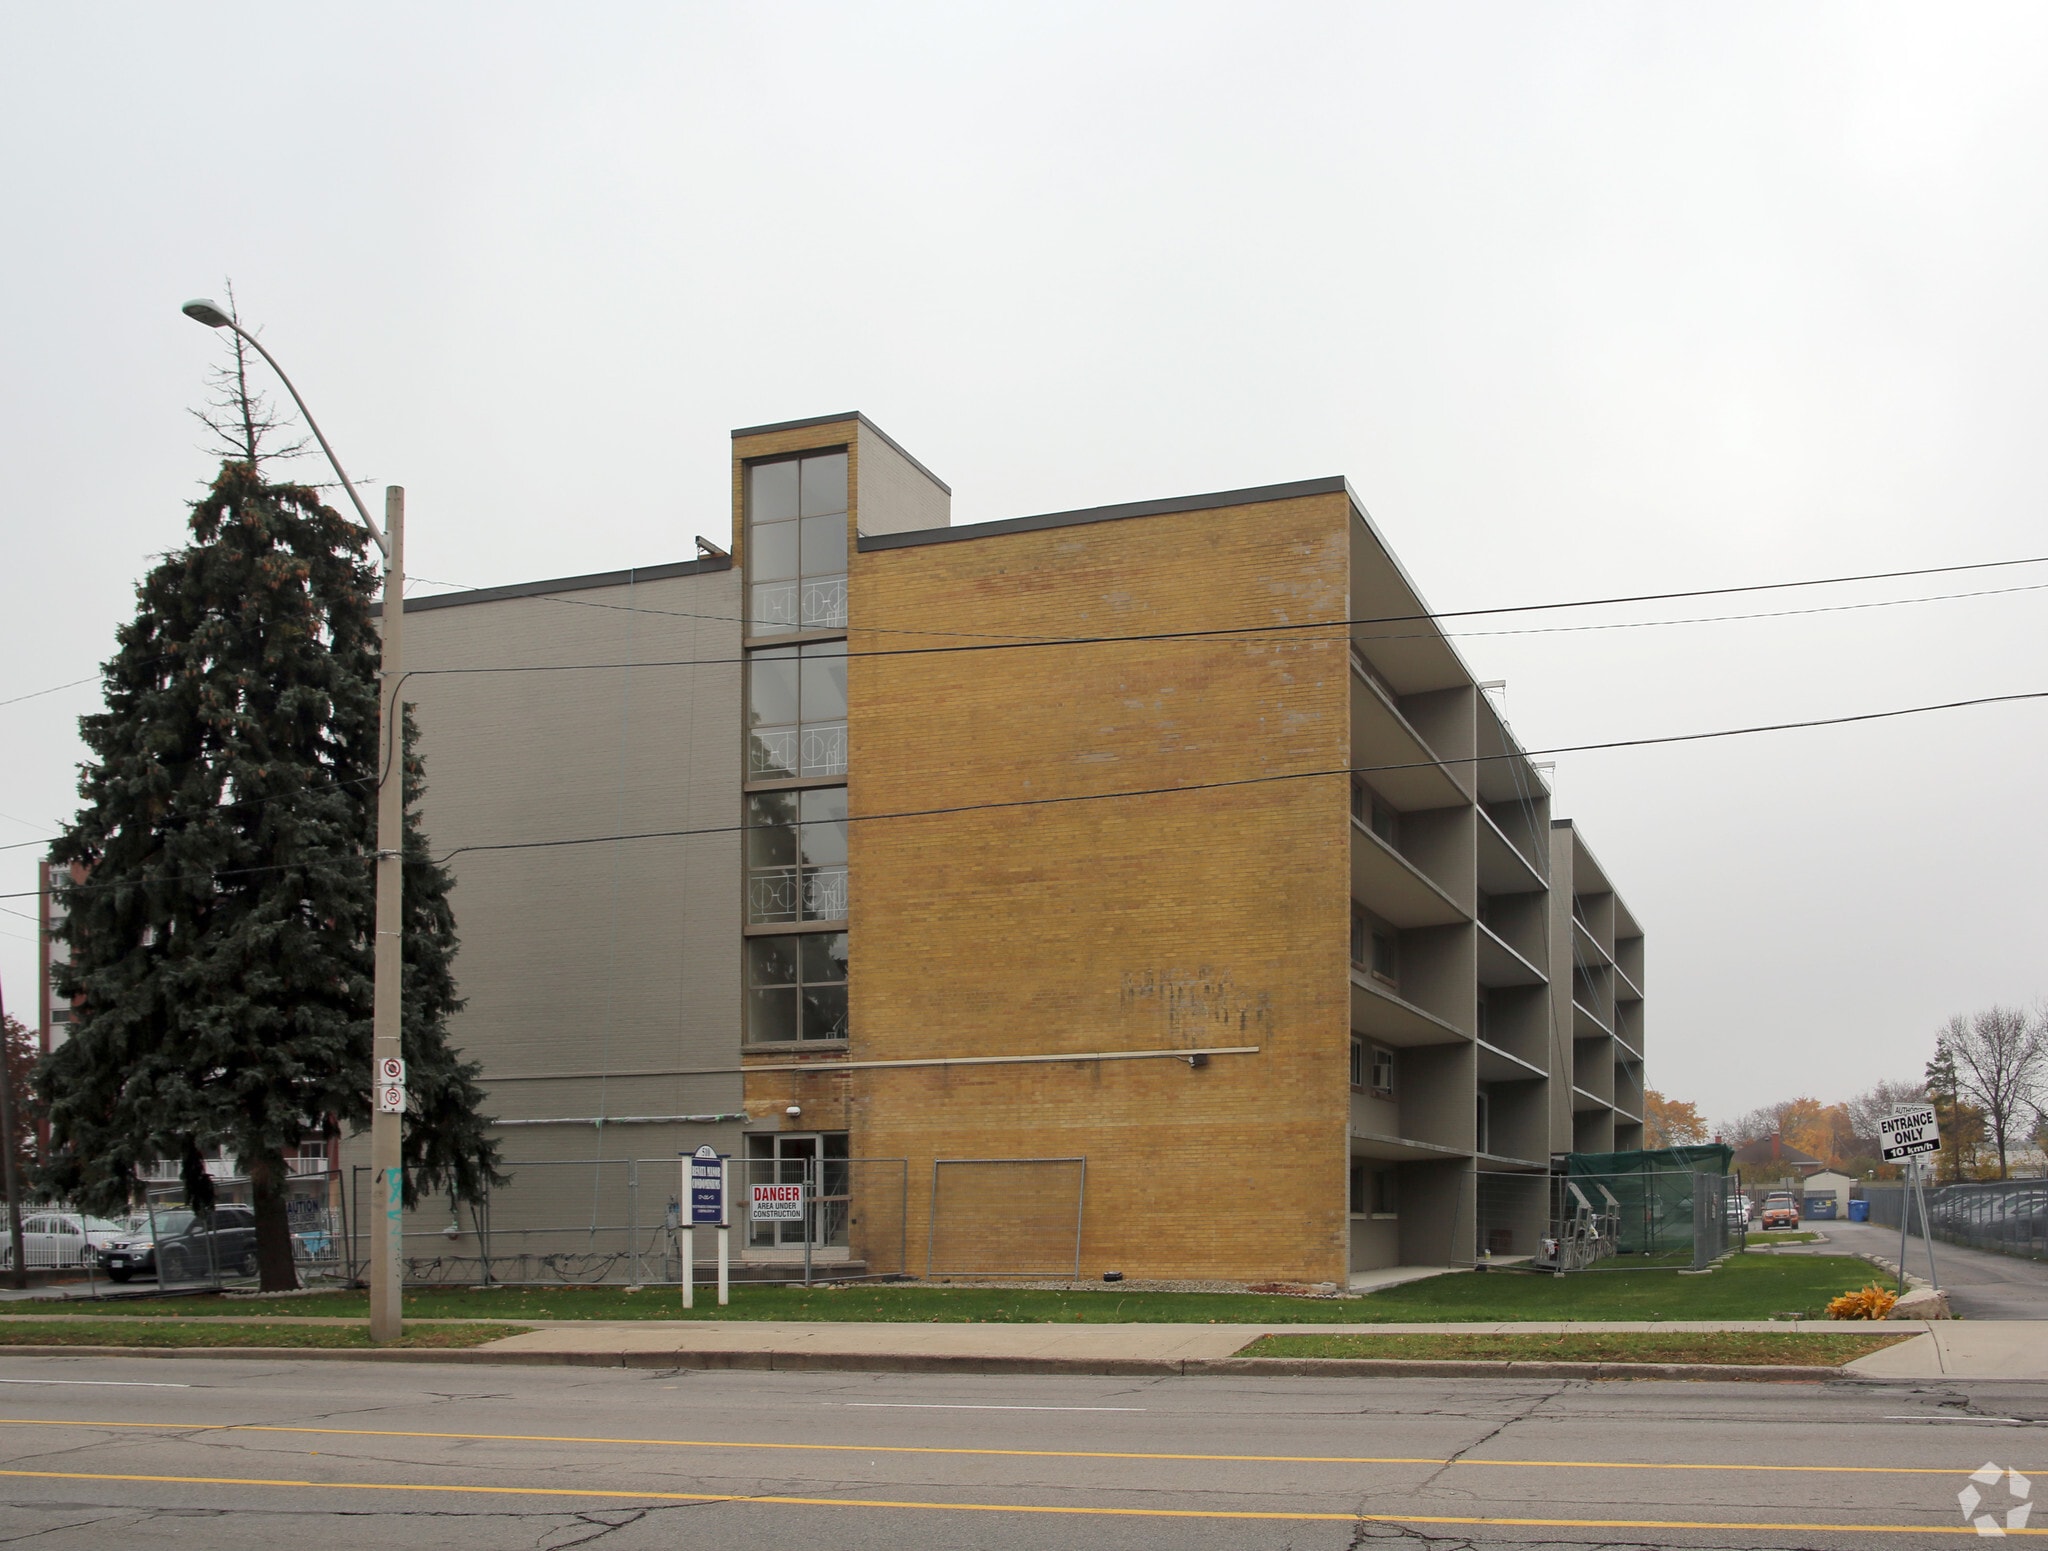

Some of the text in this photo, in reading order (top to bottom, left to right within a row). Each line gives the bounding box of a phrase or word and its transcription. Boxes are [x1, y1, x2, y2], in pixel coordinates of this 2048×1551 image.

[1881, 1112, 1933, 1133] ENTRANCE
[1894, 1128, 1923, 1144] ONLY
[1890, 1143, 1933, 1157] 10 km/h
[754, 1187, 799, 1201] DANGER
[287, 1199, 319, 1213] AUTION
[753, 1210, 801, 1218] CONSTRUCTION
